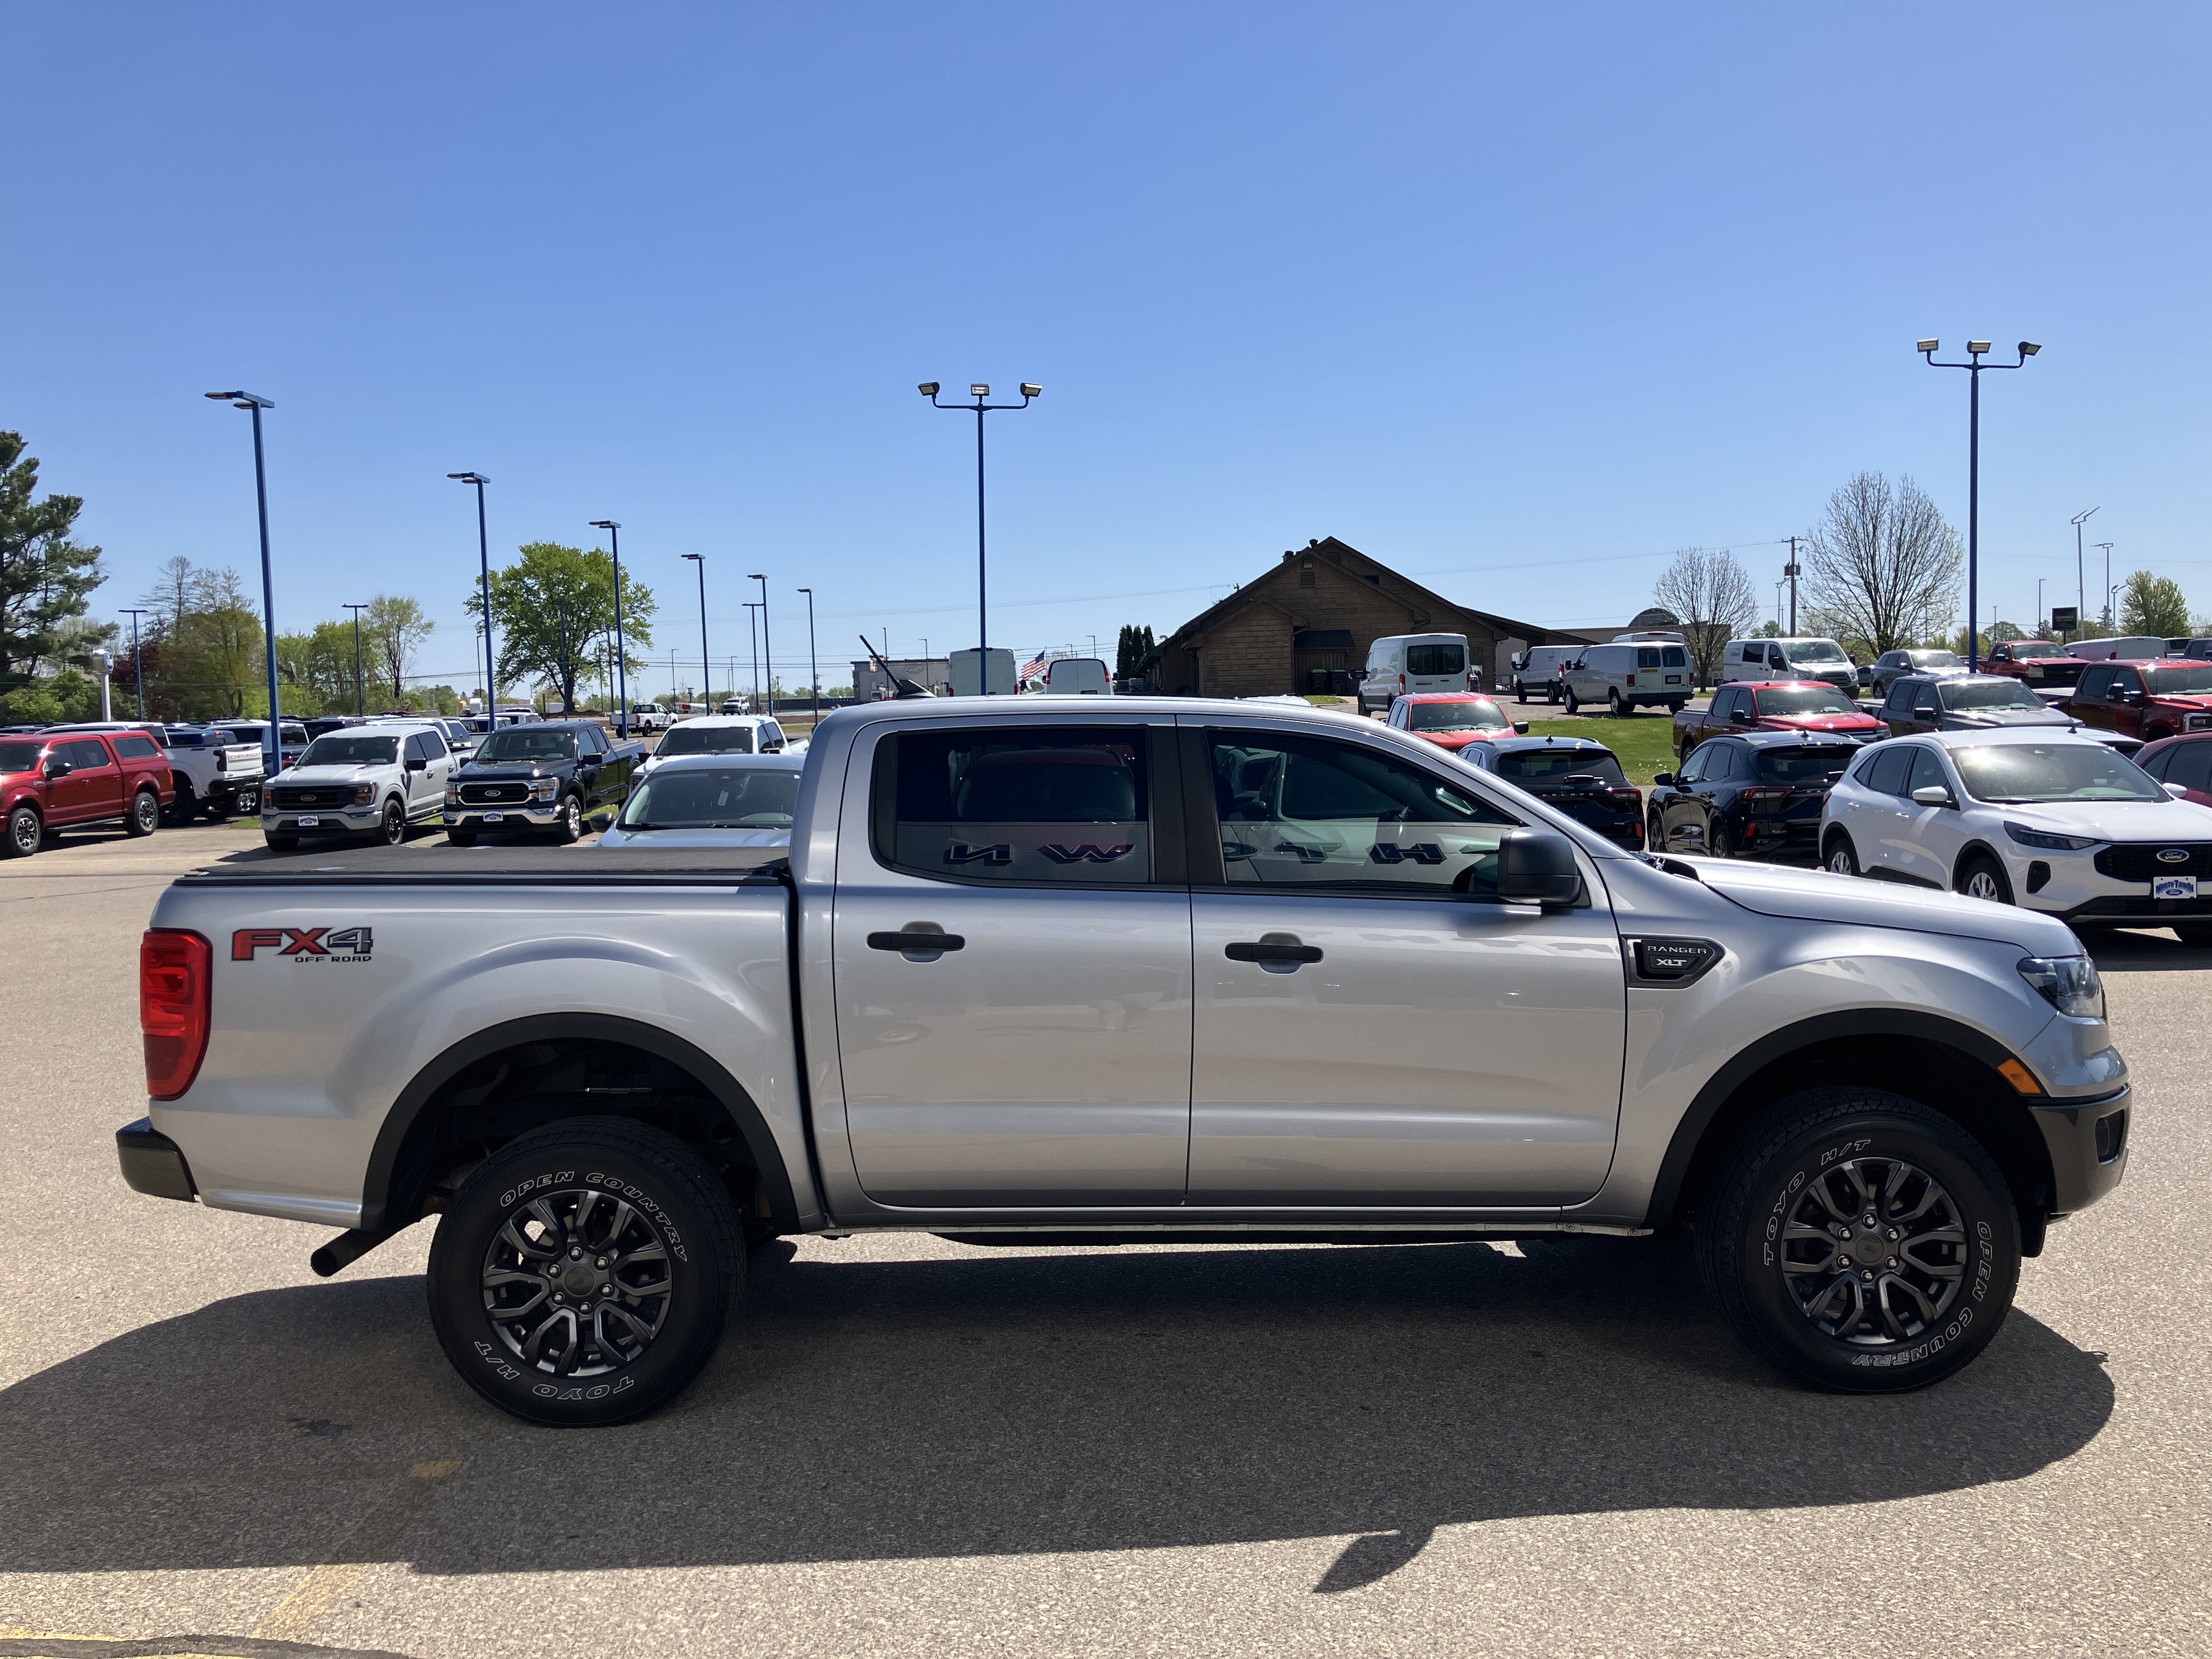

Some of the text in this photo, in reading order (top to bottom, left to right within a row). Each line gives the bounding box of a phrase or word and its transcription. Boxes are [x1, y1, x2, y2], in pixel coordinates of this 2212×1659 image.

[2164, 851, 2183, 860] Ford
[232, 927, 373, 961] FX4
[1647, 945, 1707, 954] RANGER
[1656, 958, 1687, 967] XLT
[500, 1171, 687, 1262] OPEN COUNTRY
[1764, 1139, 1871, 1266] TOYO H/T
[1852, 1221, 1993, 1367] OPEN COUNTRY
[475, 1341, 634, 1400] TOYO H/T
